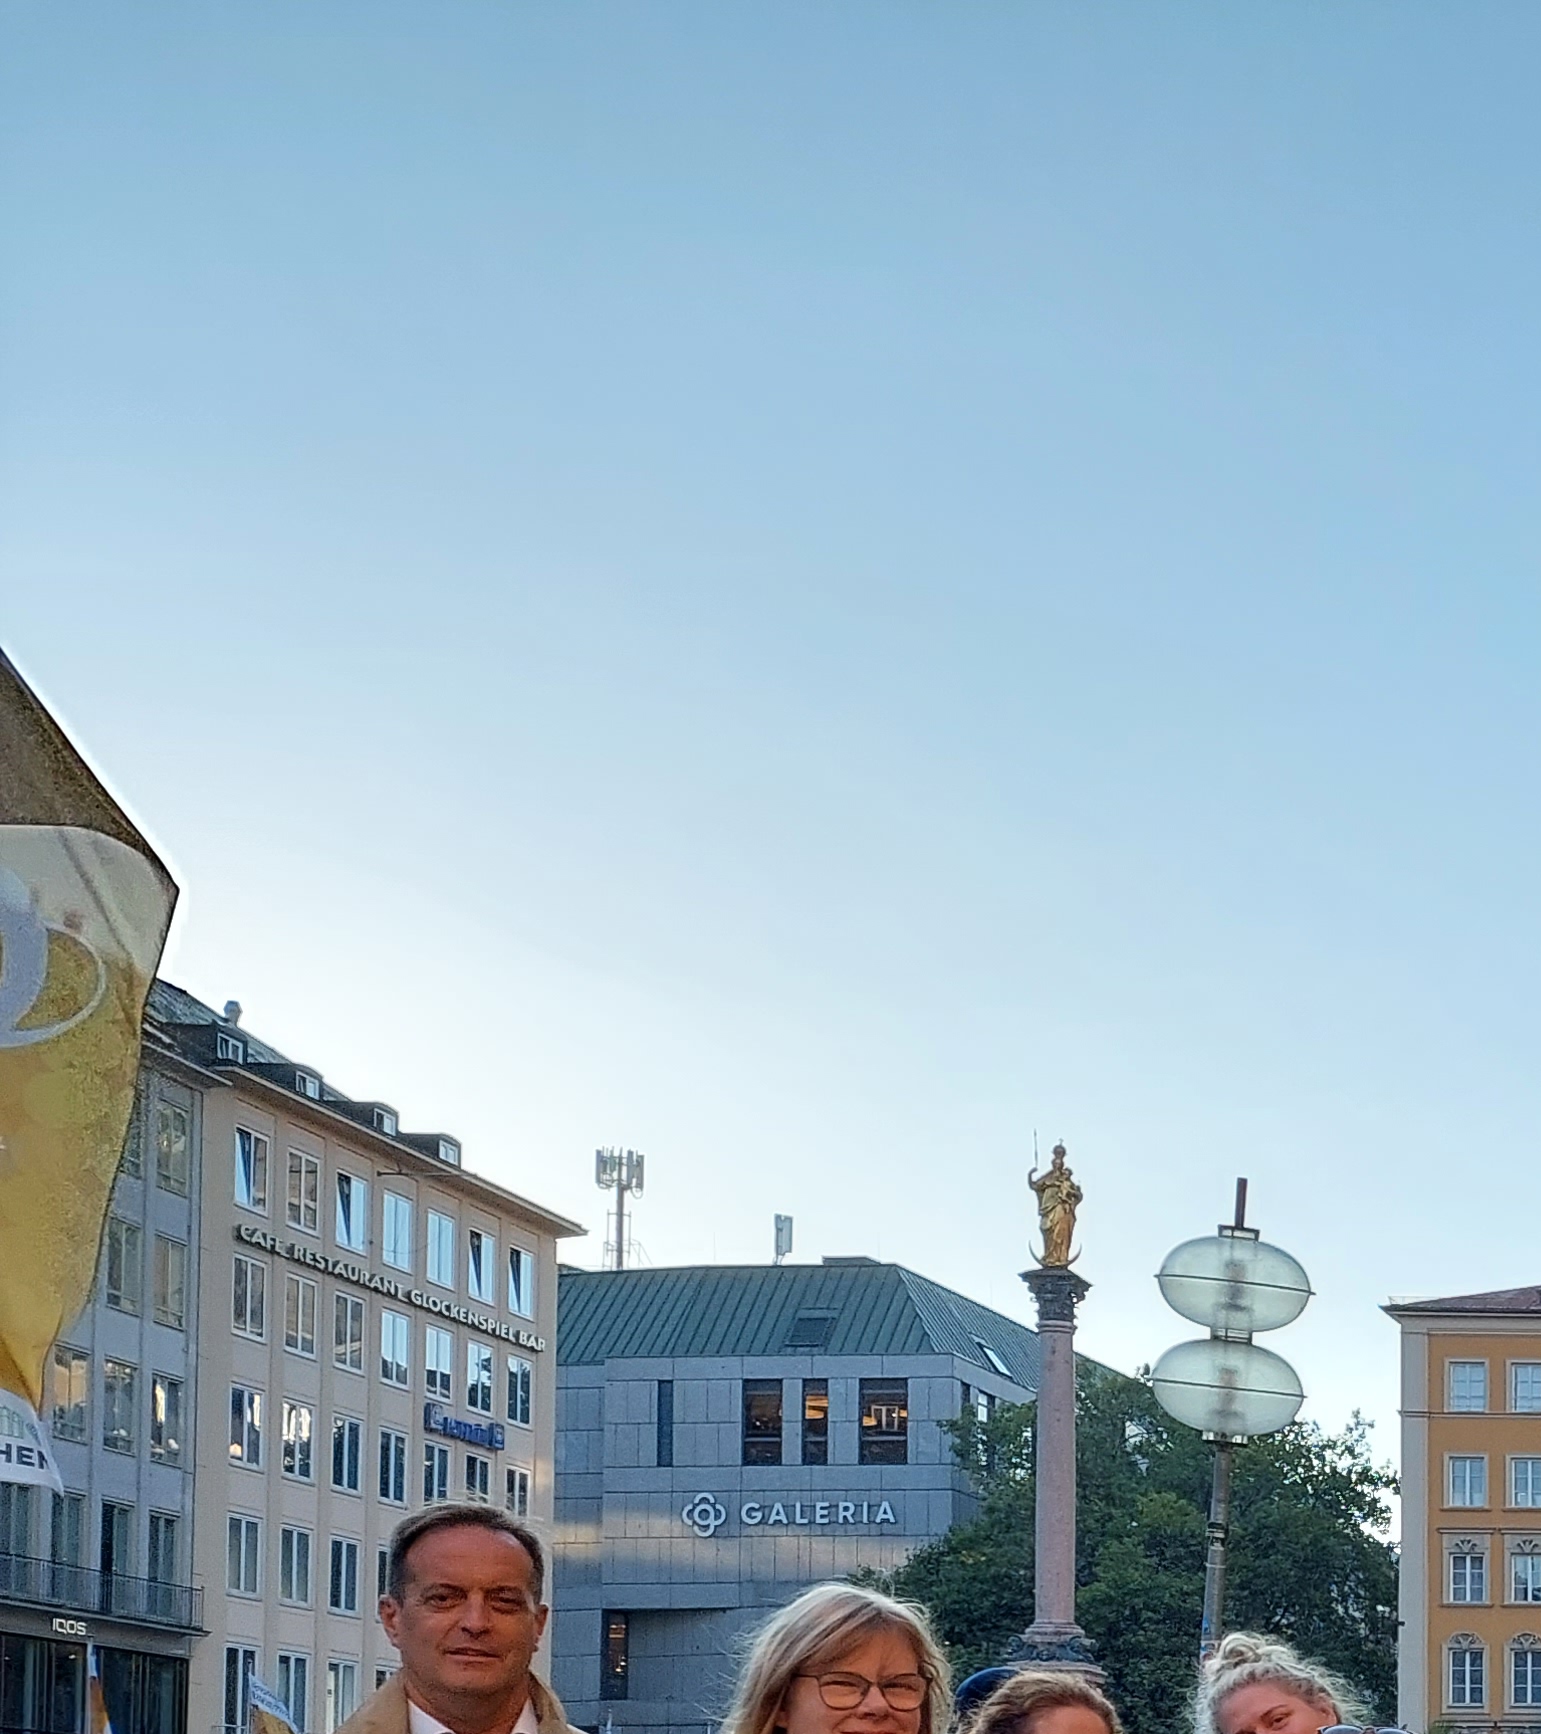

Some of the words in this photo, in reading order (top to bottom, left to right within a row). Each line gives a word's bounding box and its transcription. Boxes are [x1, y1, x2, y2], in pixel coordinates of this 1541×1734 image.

[240, 1224, 290, 1258] CAFE
[293, 1246, 408, 1303] RESTAURANT
[410, 1289, 516, 1343] GLOCKENSPIEL
[518, 1328, 546, 1352] BAR
[740, 1501, 896, 1525] GALERIA
[52, 1617, 88, 1636] IQOS
